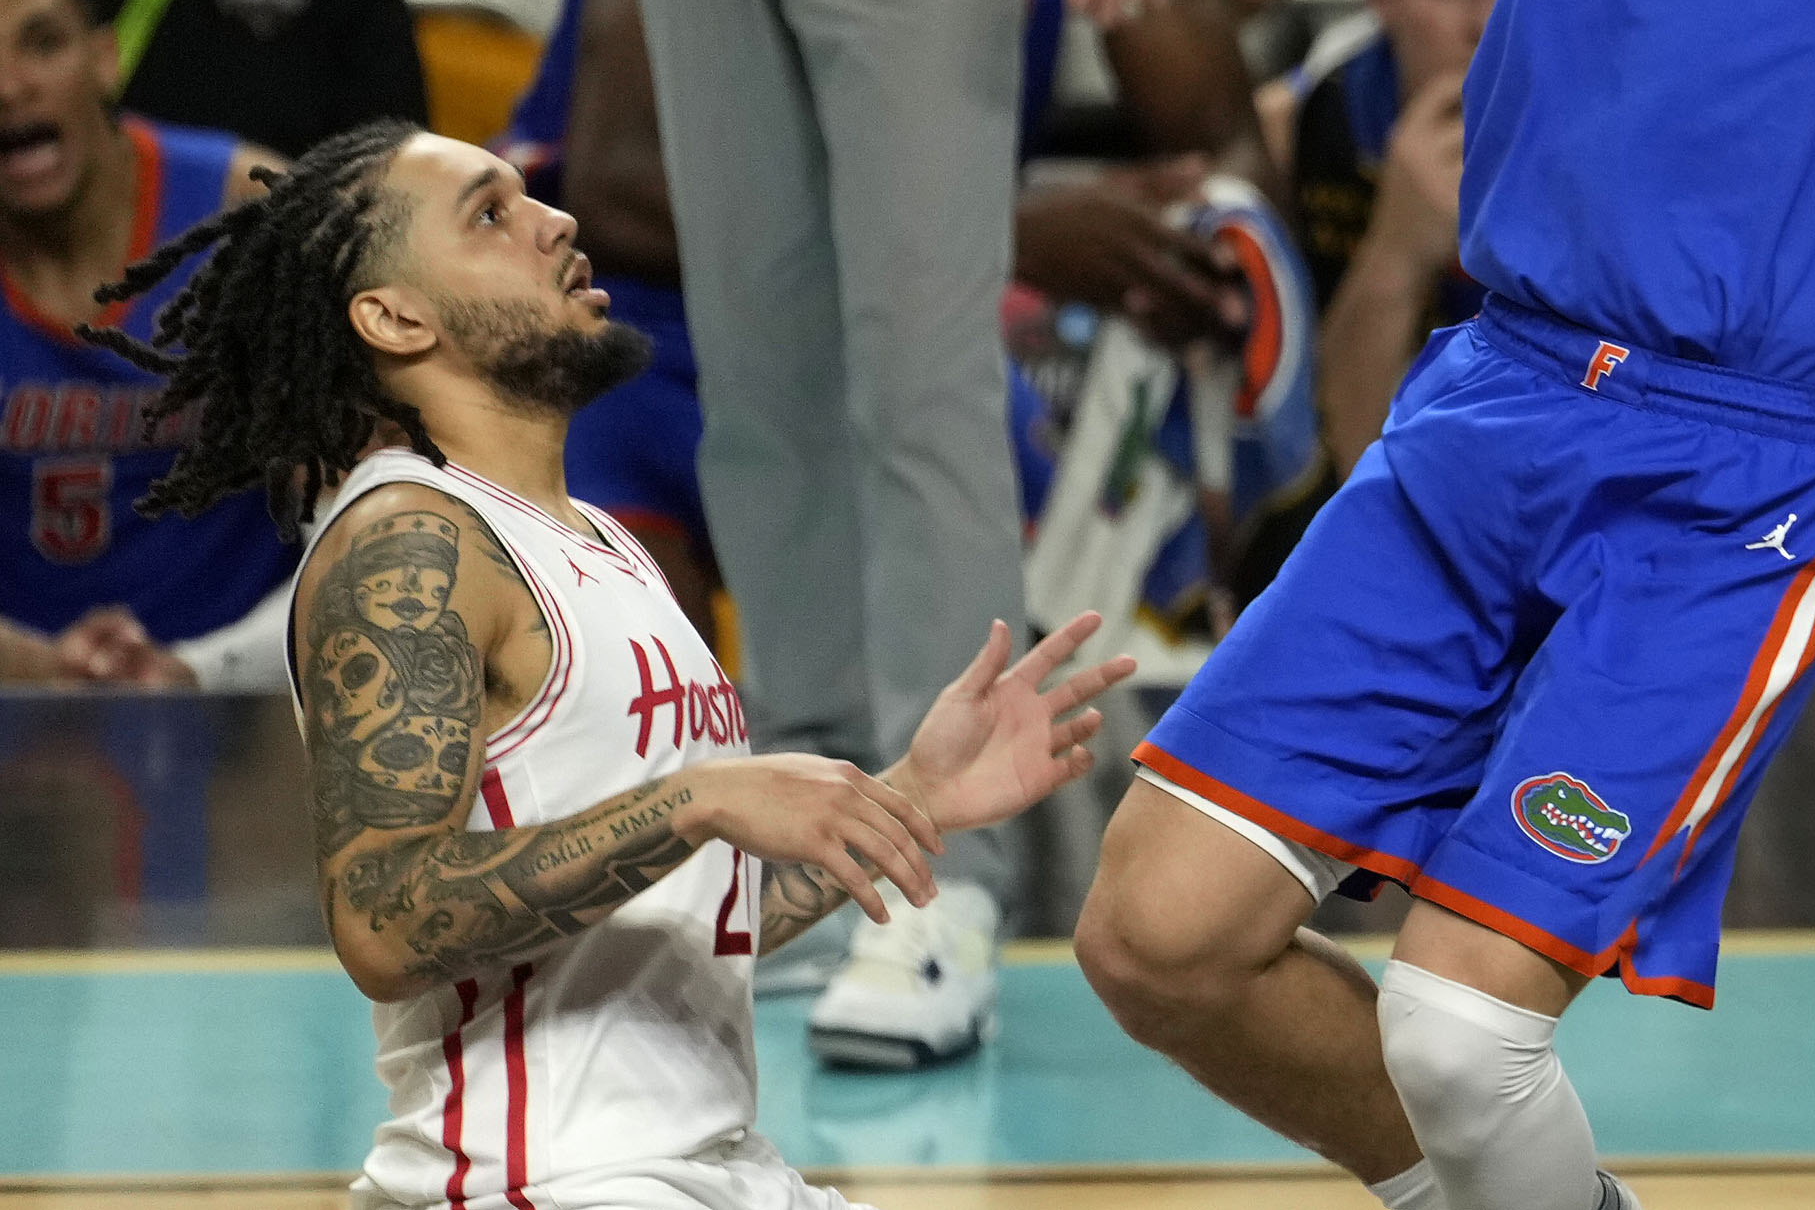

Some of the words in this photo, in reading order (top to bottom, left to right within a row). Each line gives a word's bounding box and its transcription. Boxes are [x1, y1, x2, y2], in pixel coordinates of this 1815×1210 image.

[1580, 340, 1630, 391] F
[32, 457, 112, 564] 5
[608, 788, 693, 842] MMXVII
